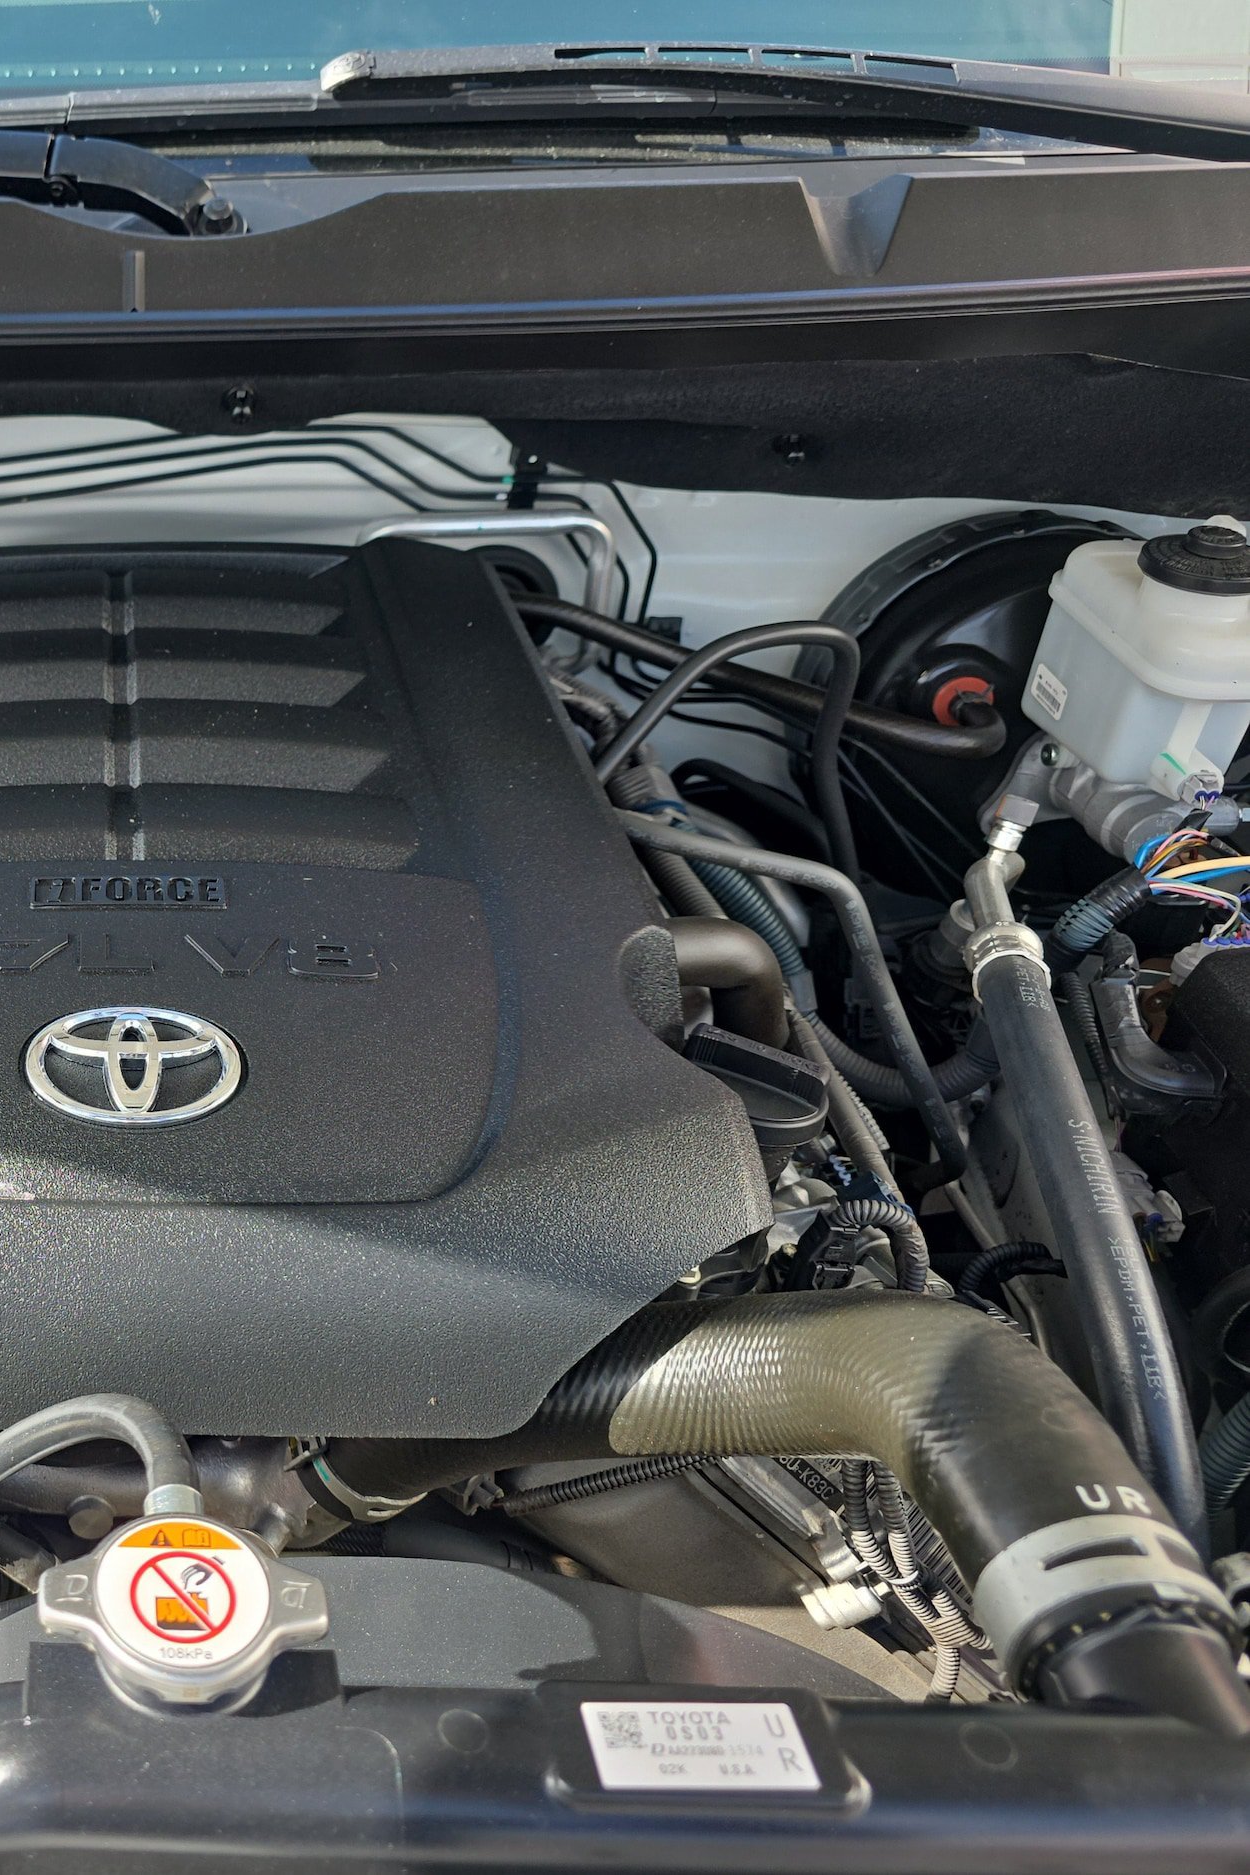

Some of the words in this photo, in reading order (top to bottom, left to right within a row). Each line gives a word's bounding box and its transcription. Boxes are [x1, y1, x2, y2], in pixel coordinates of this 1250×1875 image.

[184, 935, 379, 980] V8
[159, 1646, 213, 1661] 108kPa
[646, 1711, 731, 1725] TOYOTA
[778, 1747, 804, 1772] R
